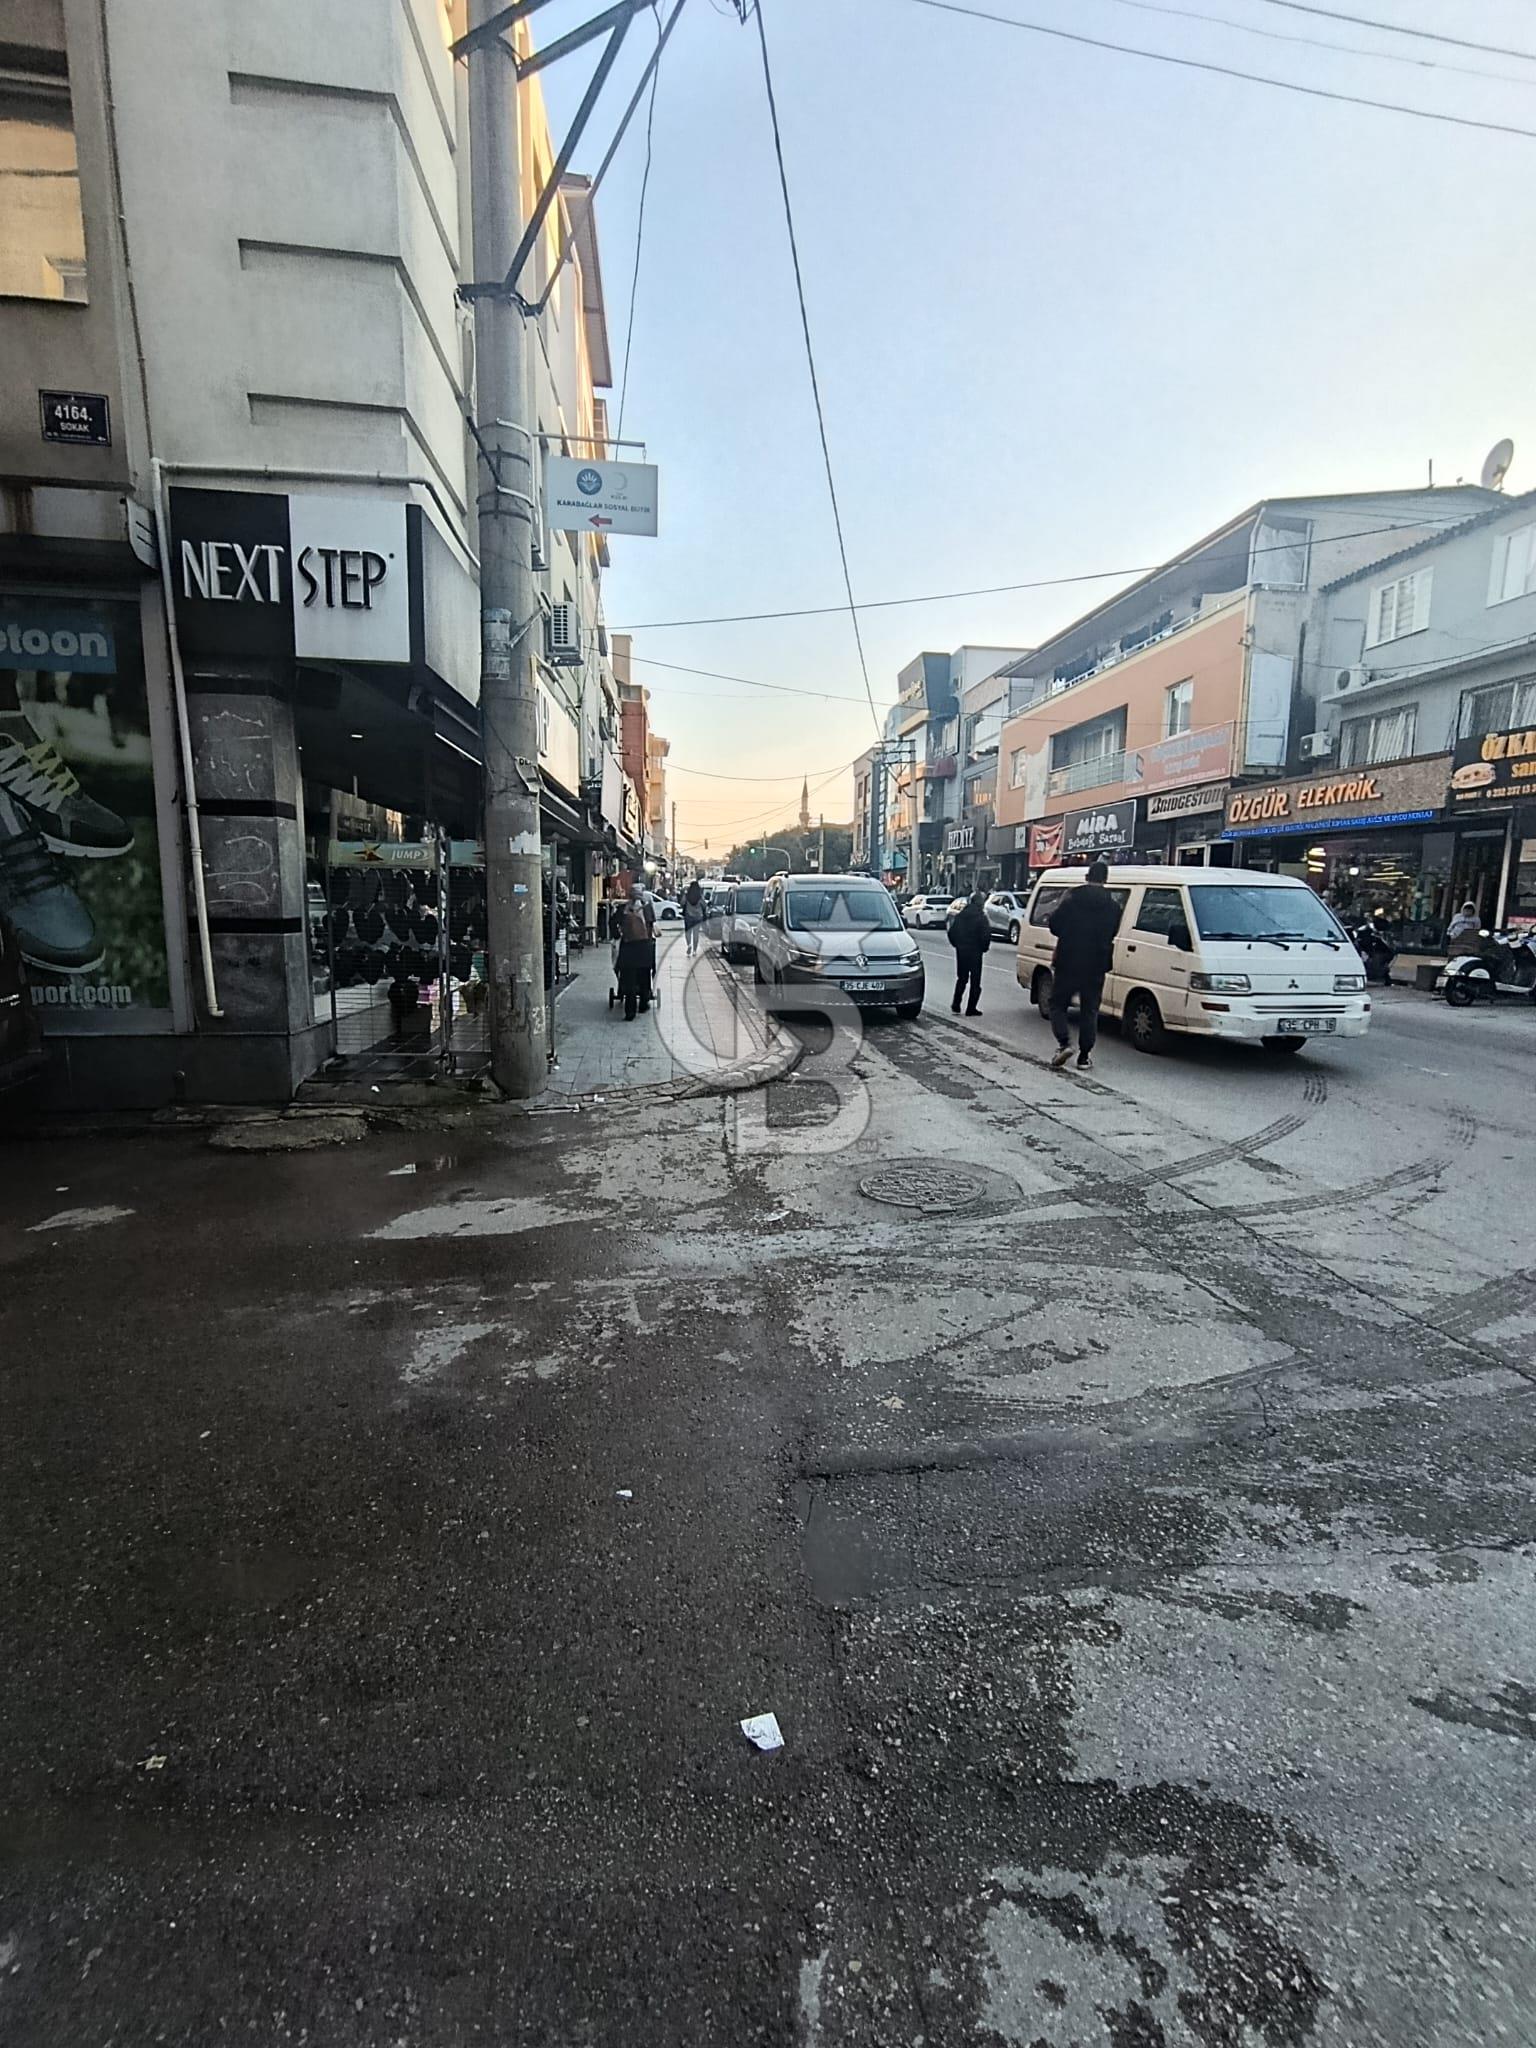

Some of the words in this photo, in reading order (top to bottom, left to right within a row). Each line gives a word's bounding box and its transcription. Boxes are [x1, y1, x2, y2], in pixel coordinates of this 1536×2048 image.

[55, 404, 93, 422] 4164.
[59, 422, 90, 432] SOKAK
[181, 539, 285, 605] NEXT
[297, 546, 389, 610] STEP
[1229, 787, 1289, 823] ÖZGÜR
[1297, 773, 1382, 809] ELEKTRİK
[1076, 810, 1119, 836] MİRA
